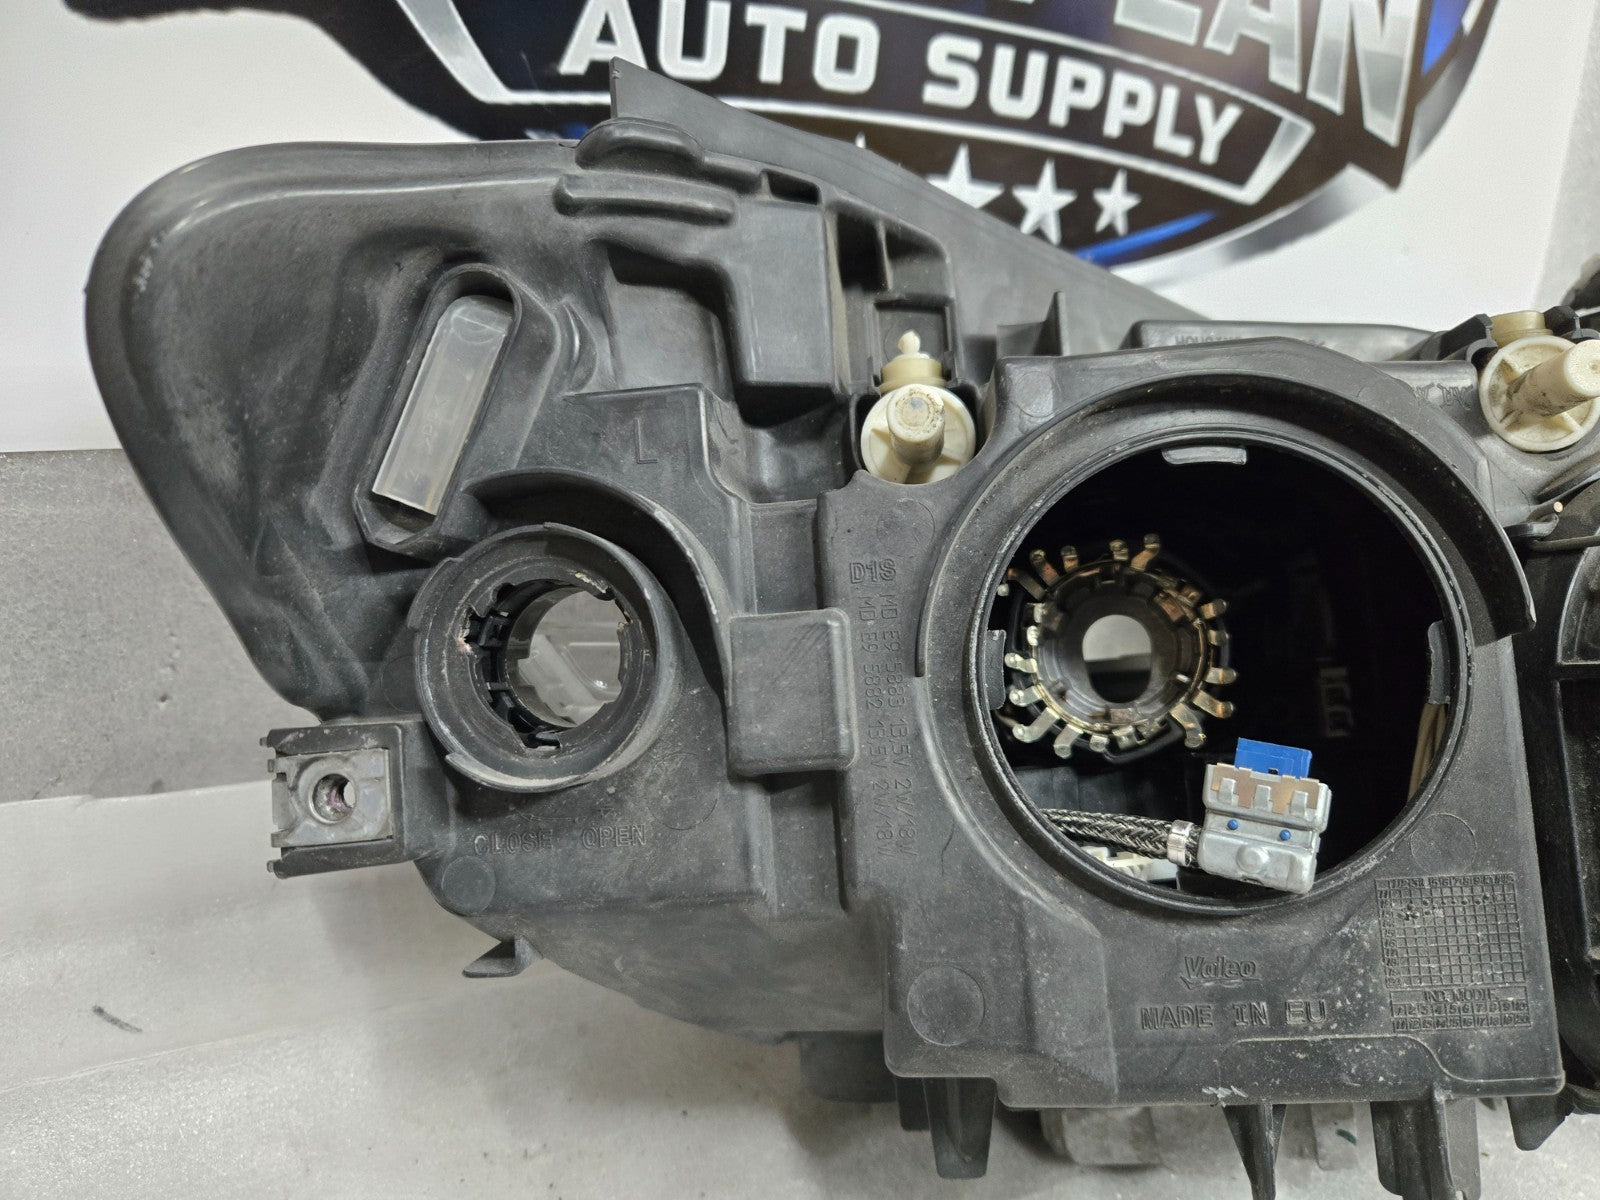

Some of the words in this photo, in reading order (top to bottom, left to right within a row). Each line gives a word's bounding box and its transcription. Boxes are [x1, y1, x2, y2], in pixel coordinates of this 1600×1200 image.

[558, 0, 880, 94] AUTO
[922, 33, 1243, 165] SUPPLY
[633, 417, 658, 464] L
[850, 558, 897, 584] D1S
[861, 631, 879, 653] E9
[883, 630, 901, 652] E9
[474, 832, 554, 856] CLOSE
[581, 824, 649, 849] OPEN
[1184, 956, 1256, 980] Valeo
[1140, 1003, 1214, 1030] MADE
[1231, 1001, 1270, 1027] IN
[1285, 999, 1327, 1025] EU
